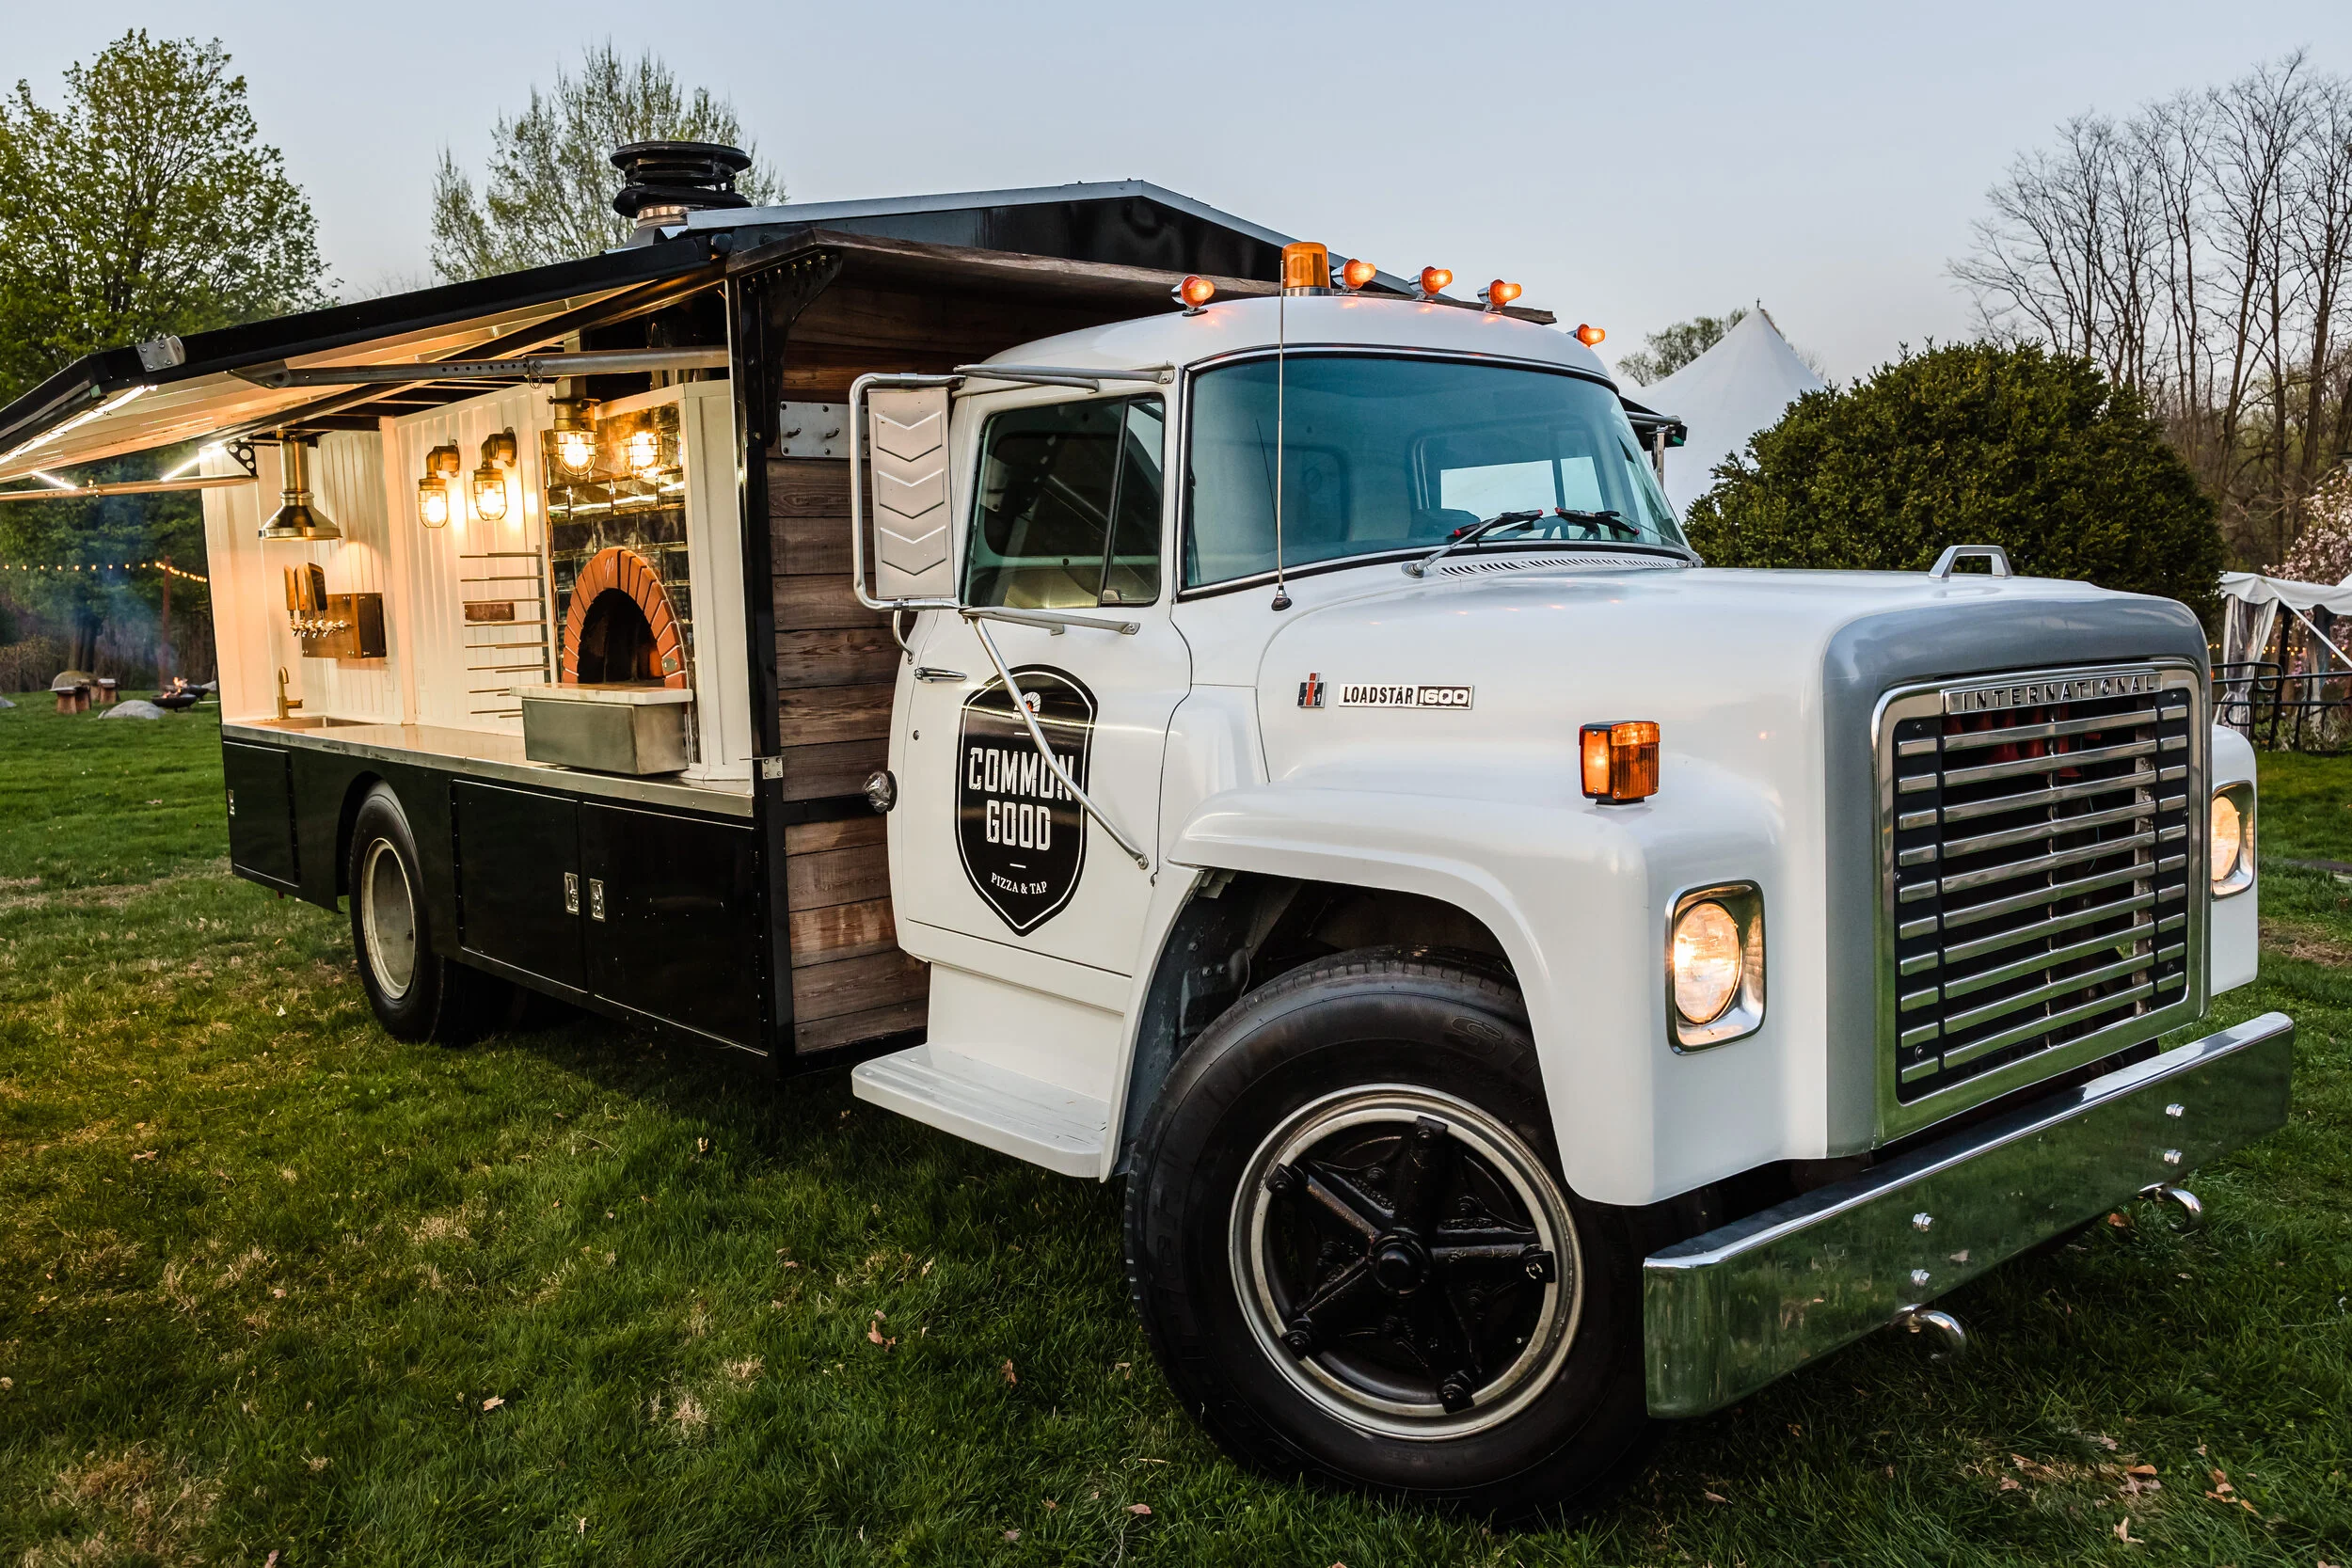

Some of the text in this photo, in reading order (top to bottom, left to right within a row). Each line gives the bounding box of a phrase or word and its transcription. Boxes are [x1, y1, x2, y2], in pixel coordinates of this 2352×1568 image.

[1343, 686, 1469, 705] LOADSTAR 1600
[1962, 675, 2154, 711] INTERNATIONAL
[968, 747, 1074, 801] COMMON
[986, 800, 1051, 851] GOOD
[991, 871, 1047, 895] PIZZA & TAP
